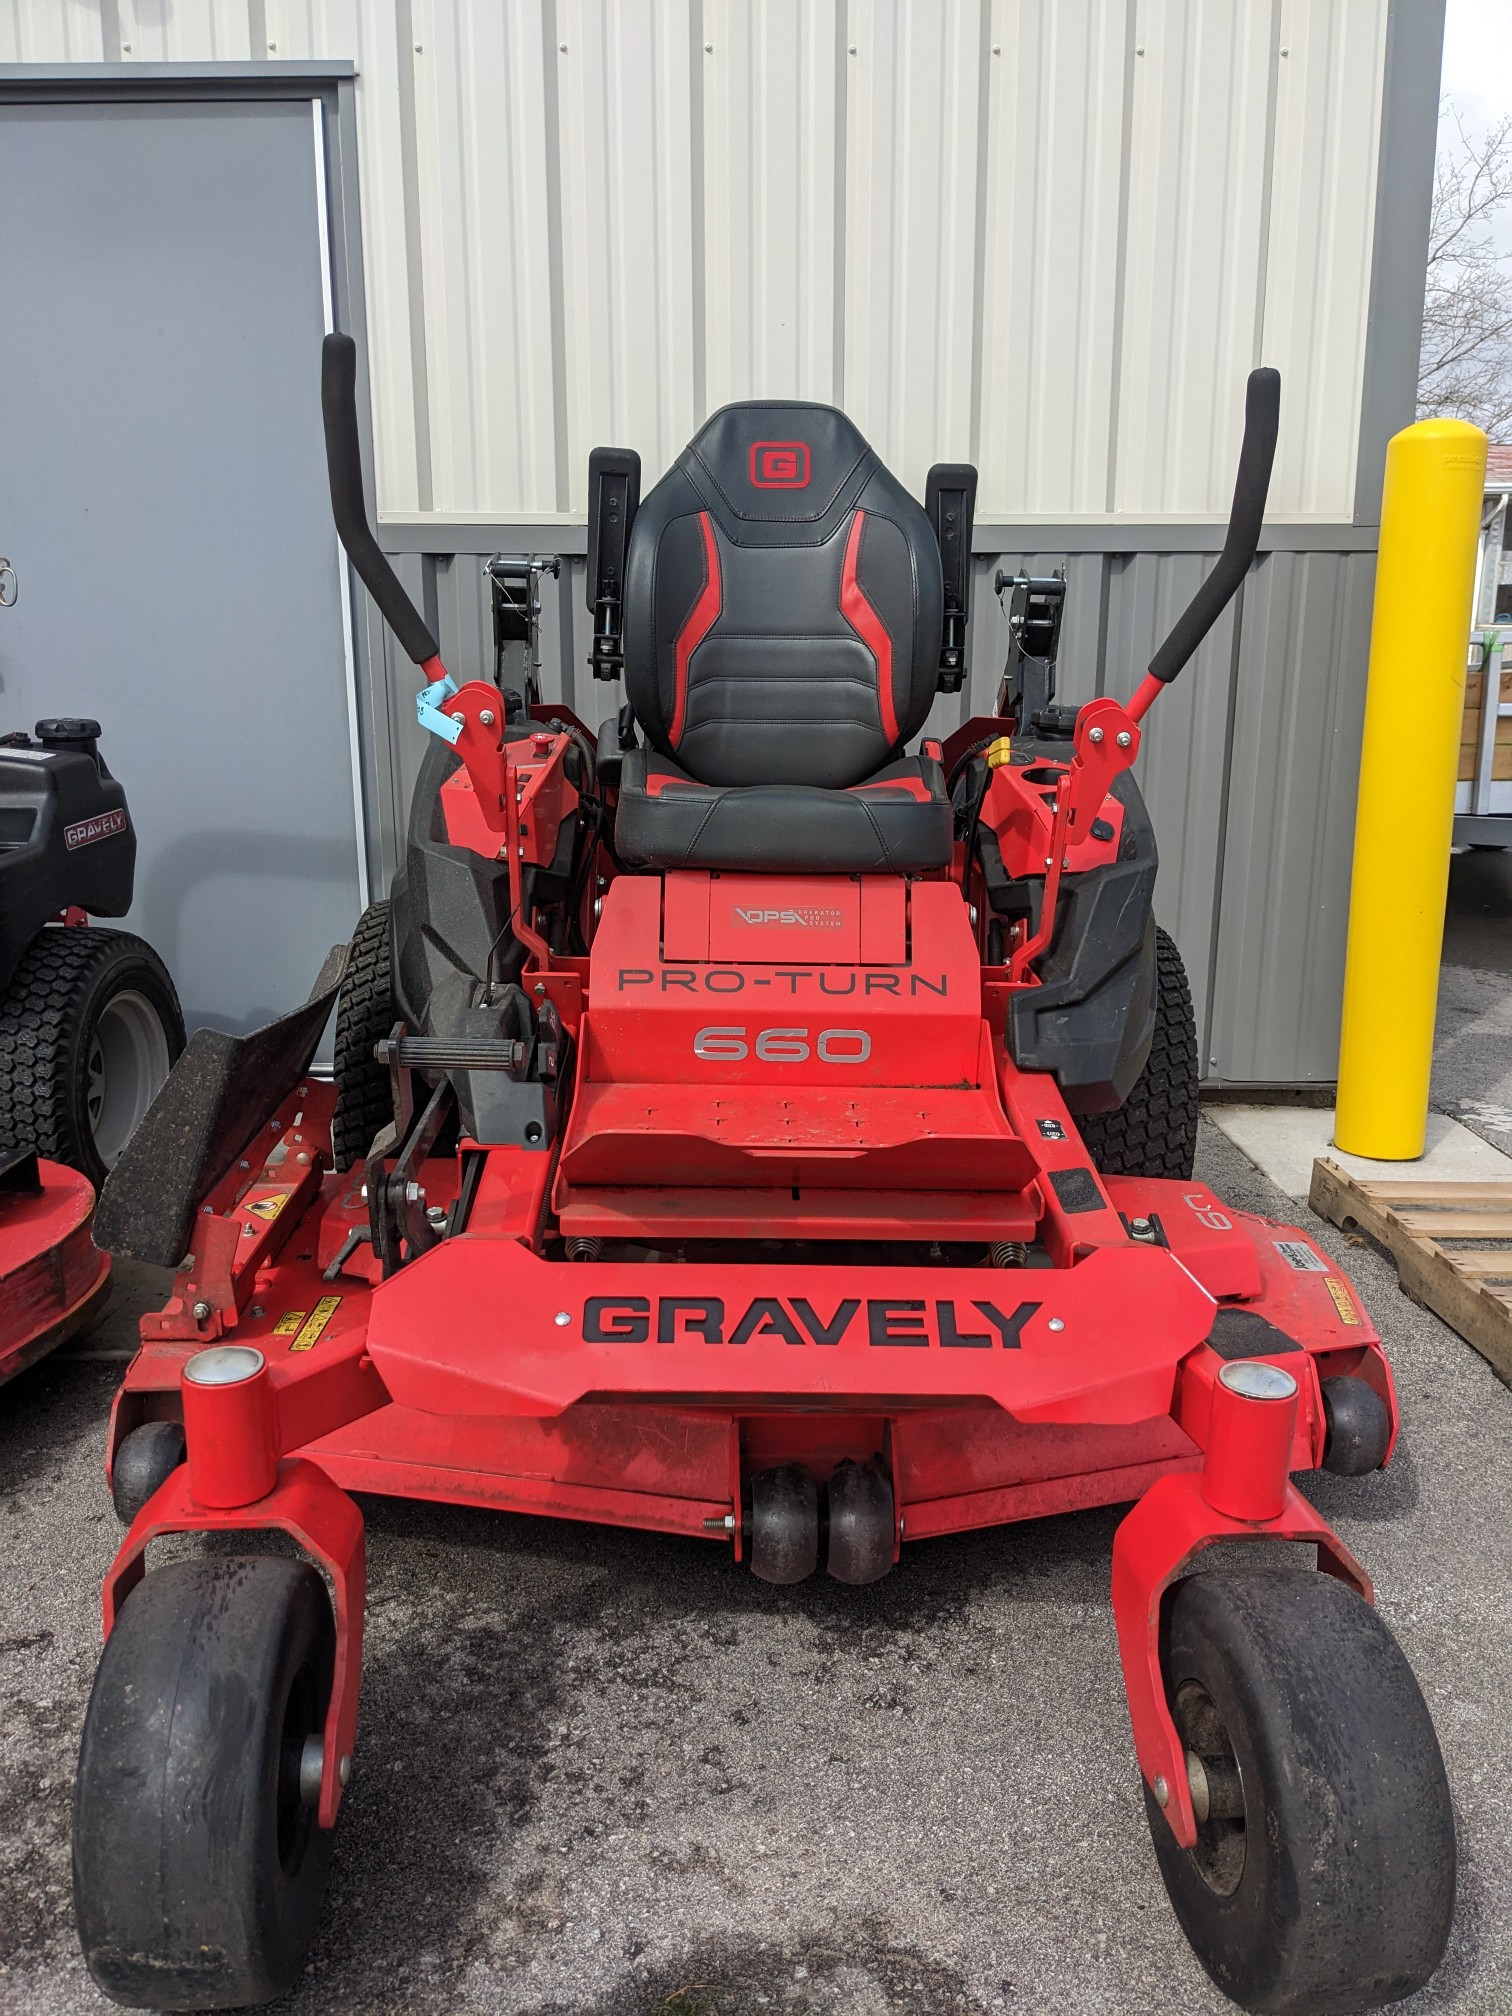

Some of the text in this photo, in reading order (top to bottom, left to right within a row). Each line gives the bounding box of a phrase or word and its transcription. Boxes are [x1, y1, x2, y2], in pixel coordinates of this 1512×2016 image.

[67, 812, 122, 845] GRAVELY
[745, 909, 797, 924] OPS
[618, 969, 948, 996] PRO-TURN
[693, 1026, 872, 1063] 660
[582, 1295, 1044, 1349] GRAVELY
